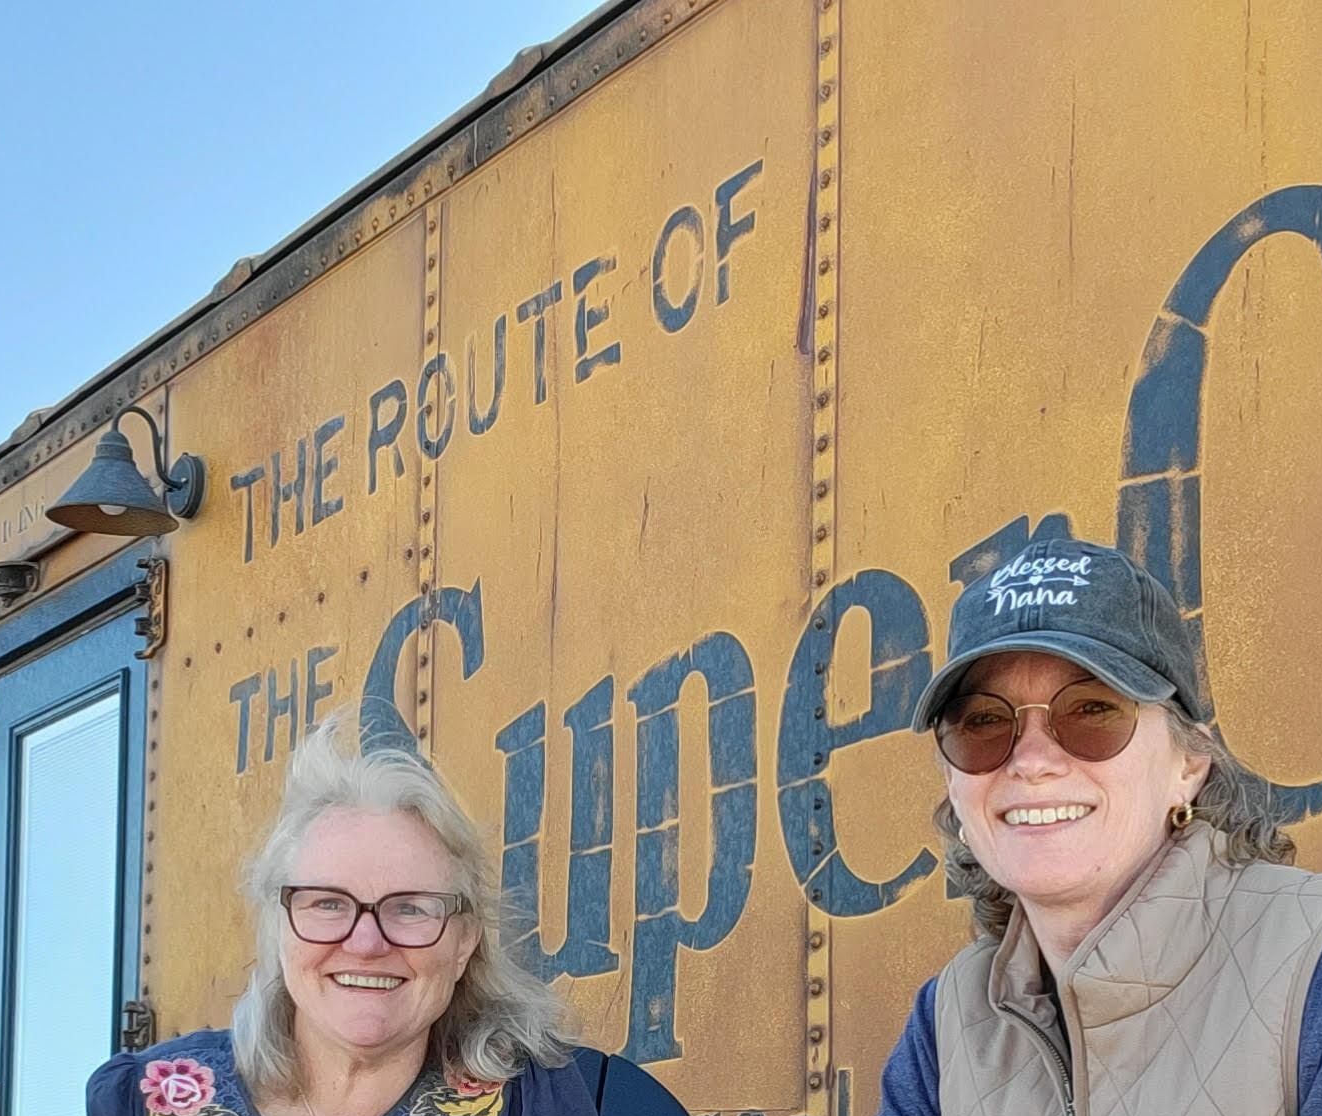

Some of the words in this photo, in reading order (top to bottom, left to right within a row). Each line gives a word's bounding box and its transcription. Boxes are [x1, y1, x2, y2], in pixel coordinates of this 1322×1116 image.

[230, 415, 345, 565] THE
[367, 255, 623, 496] ROUTE
[652, 158, 765, 334] OF
[359, 511, 1075, 1064] Supe
